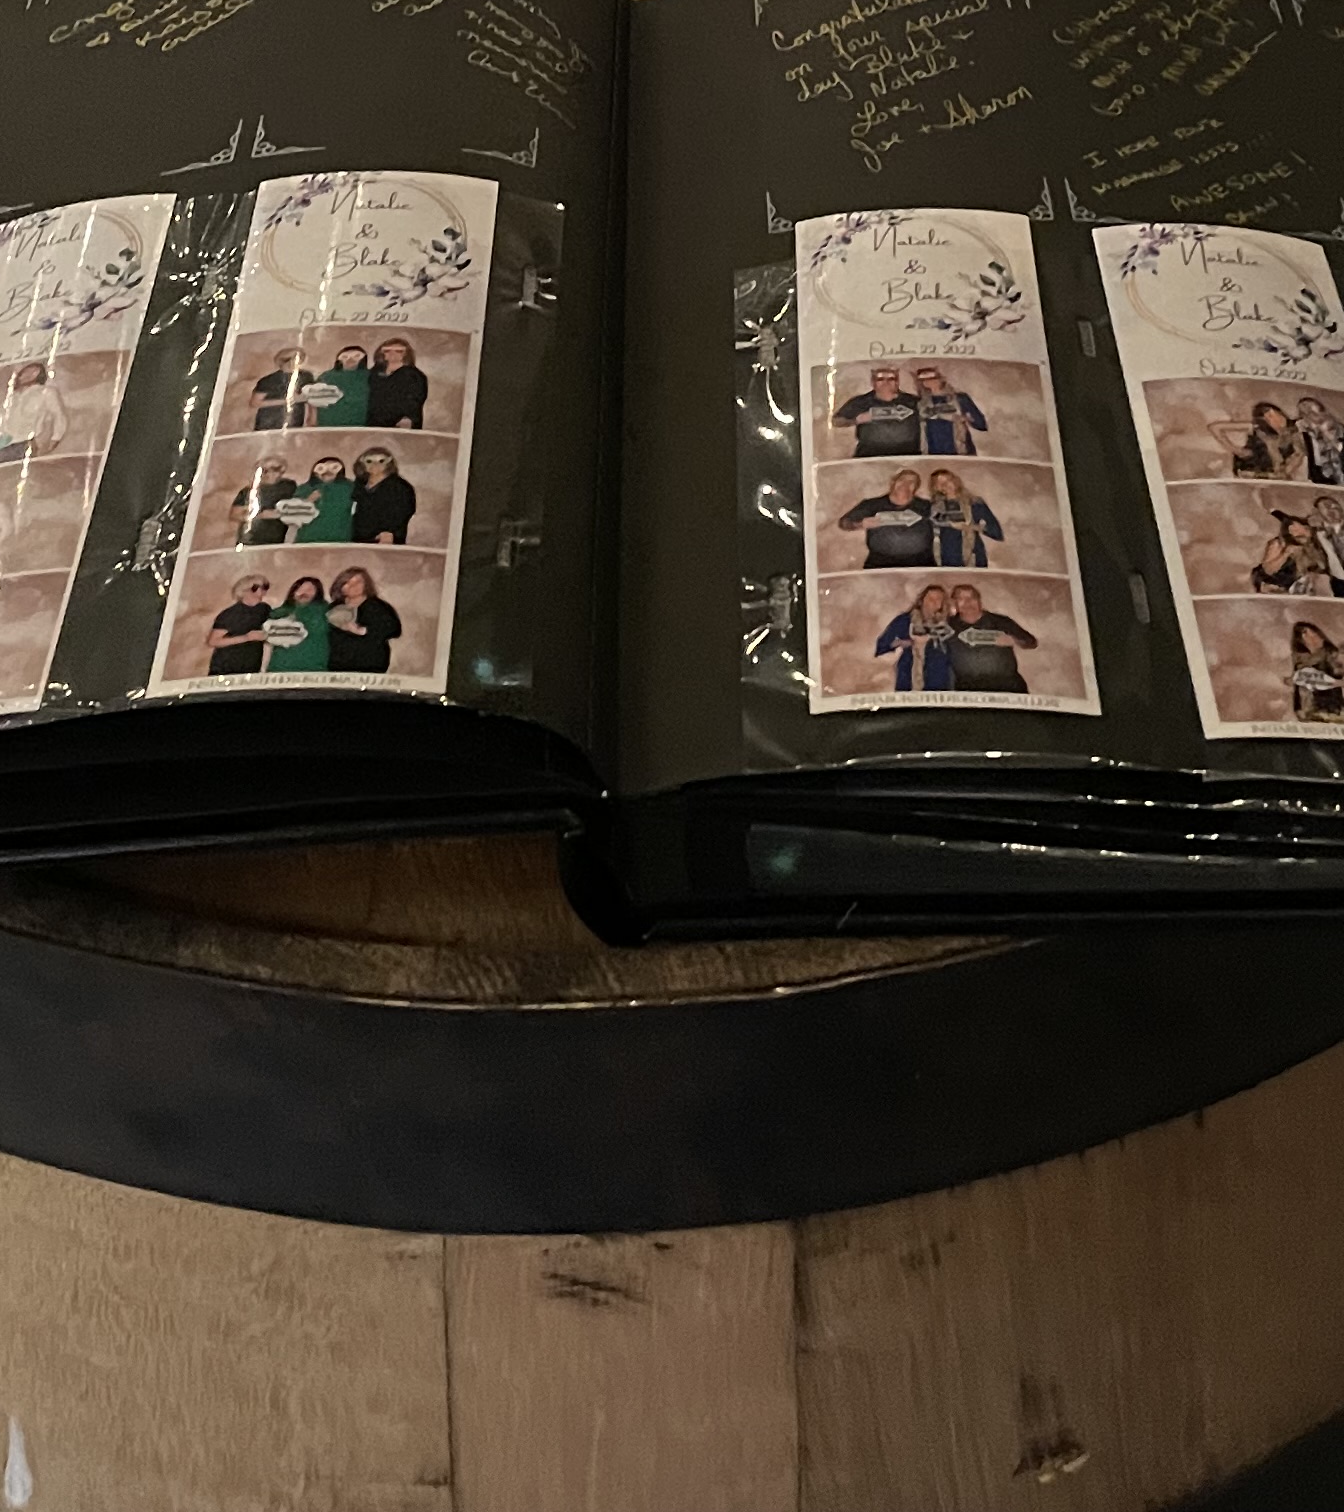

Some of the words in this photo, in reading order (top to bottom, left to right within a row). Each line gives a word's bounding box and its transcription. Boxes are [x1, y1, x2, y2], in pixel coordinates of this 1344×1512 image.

[864, 34, 947, 76] Blake
[934, 86, 1033, 131] Sharon
[329, 187, 416, 221] Natalie
[872, 226, 954, 260] Natalie
[1179, 238, 1264, 275] Natalie
[322, 243, 403, 280] Blake
[903, 259, 927, 275] &
[879, 277, 957, 315] Blake
[1219, 277, 1244, 294] &
[350, 311, 369, 322] 22
[373, 311, 409, 324] 2022
[1197, 295, 1278, 332] Blake
[920, 344, 936, 355] 22
[942, 344, 976, 355] 2022
